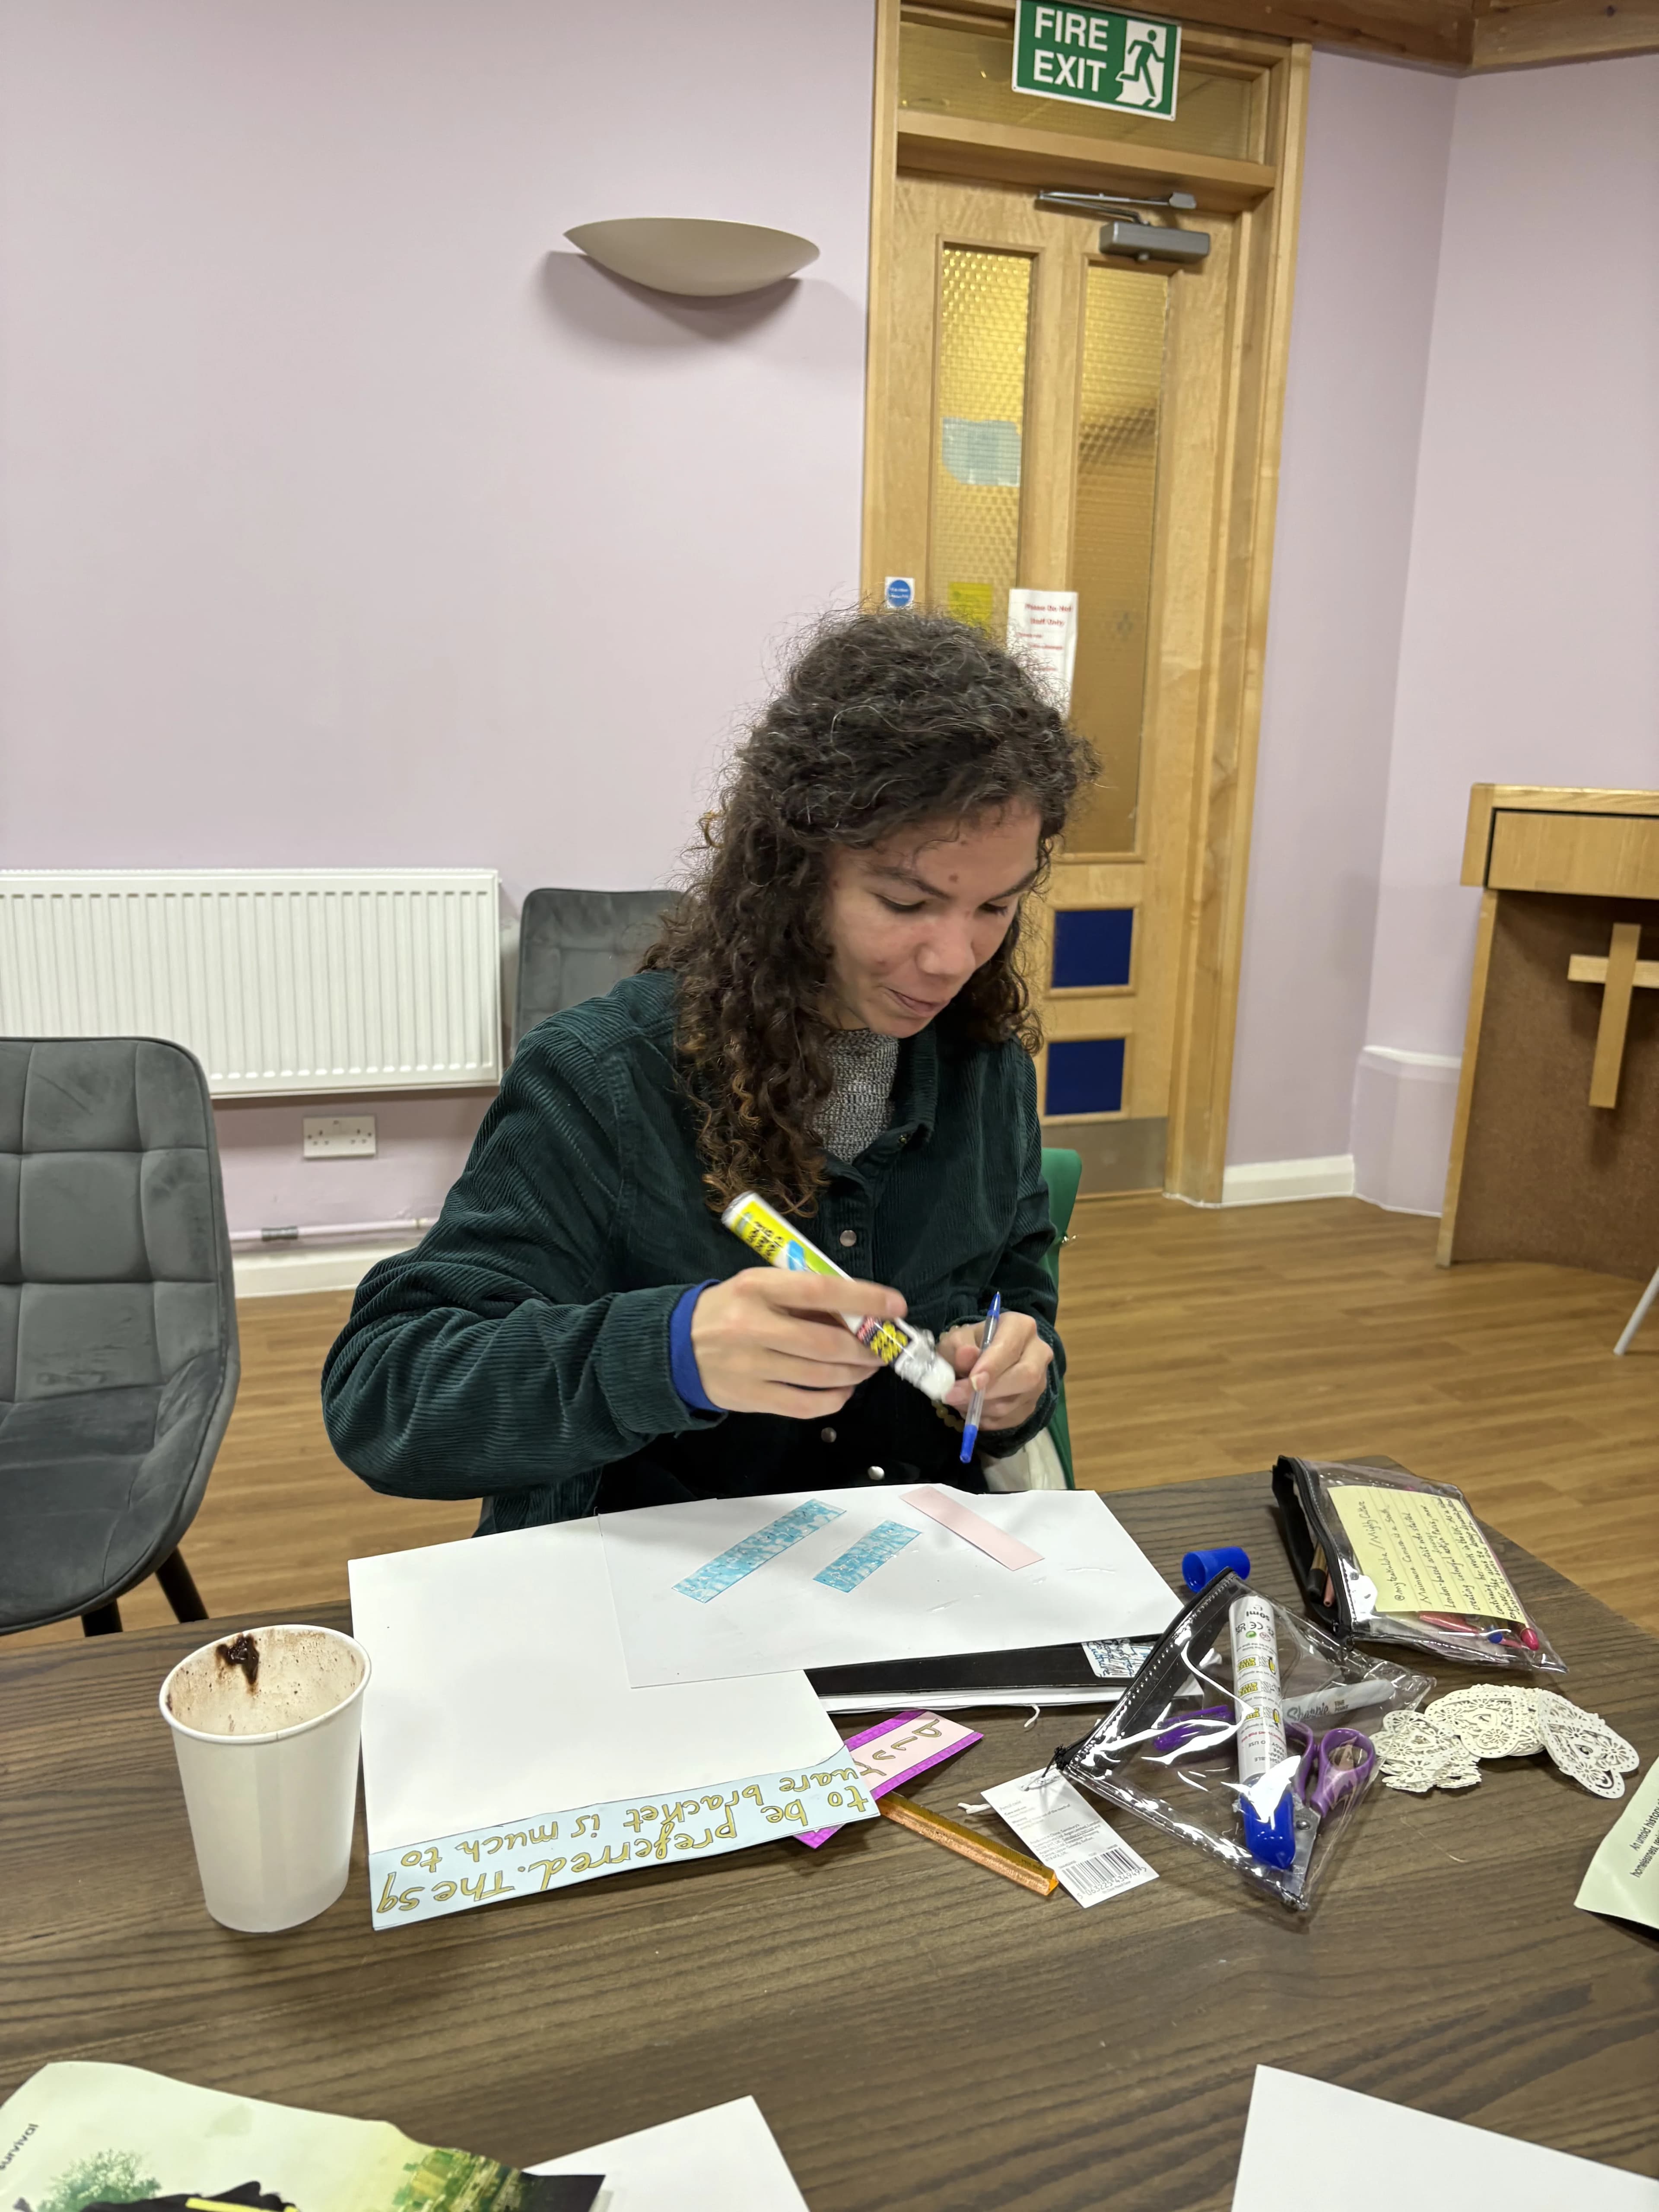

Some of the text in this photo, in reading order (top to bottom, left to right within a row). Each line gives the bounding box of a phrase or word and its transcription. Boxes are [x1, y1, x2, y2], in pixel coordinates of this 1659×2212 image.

[1035, 6, 1109, 51] FIRE
[1033, 49, 1106, 92] EXIT
[1462, 1585, 1480, 1610] creating
[1246, 1611, 1270, 1622] 50ml
[625, 1785, 763, 1831] bracket
[828, 1786, 868, 1812] to
[759, 1799, 807, 1826] be
[571, 1814, 600, 1838] is
[1637, 1827, 1651, 1843] untold
[456, 1822, 558, 1862] much
[401, 1847, 442, 1872] to
[1084, 1880, 1114, 1896] 063225
[1113, 1869, 1142, 1884] 434949
